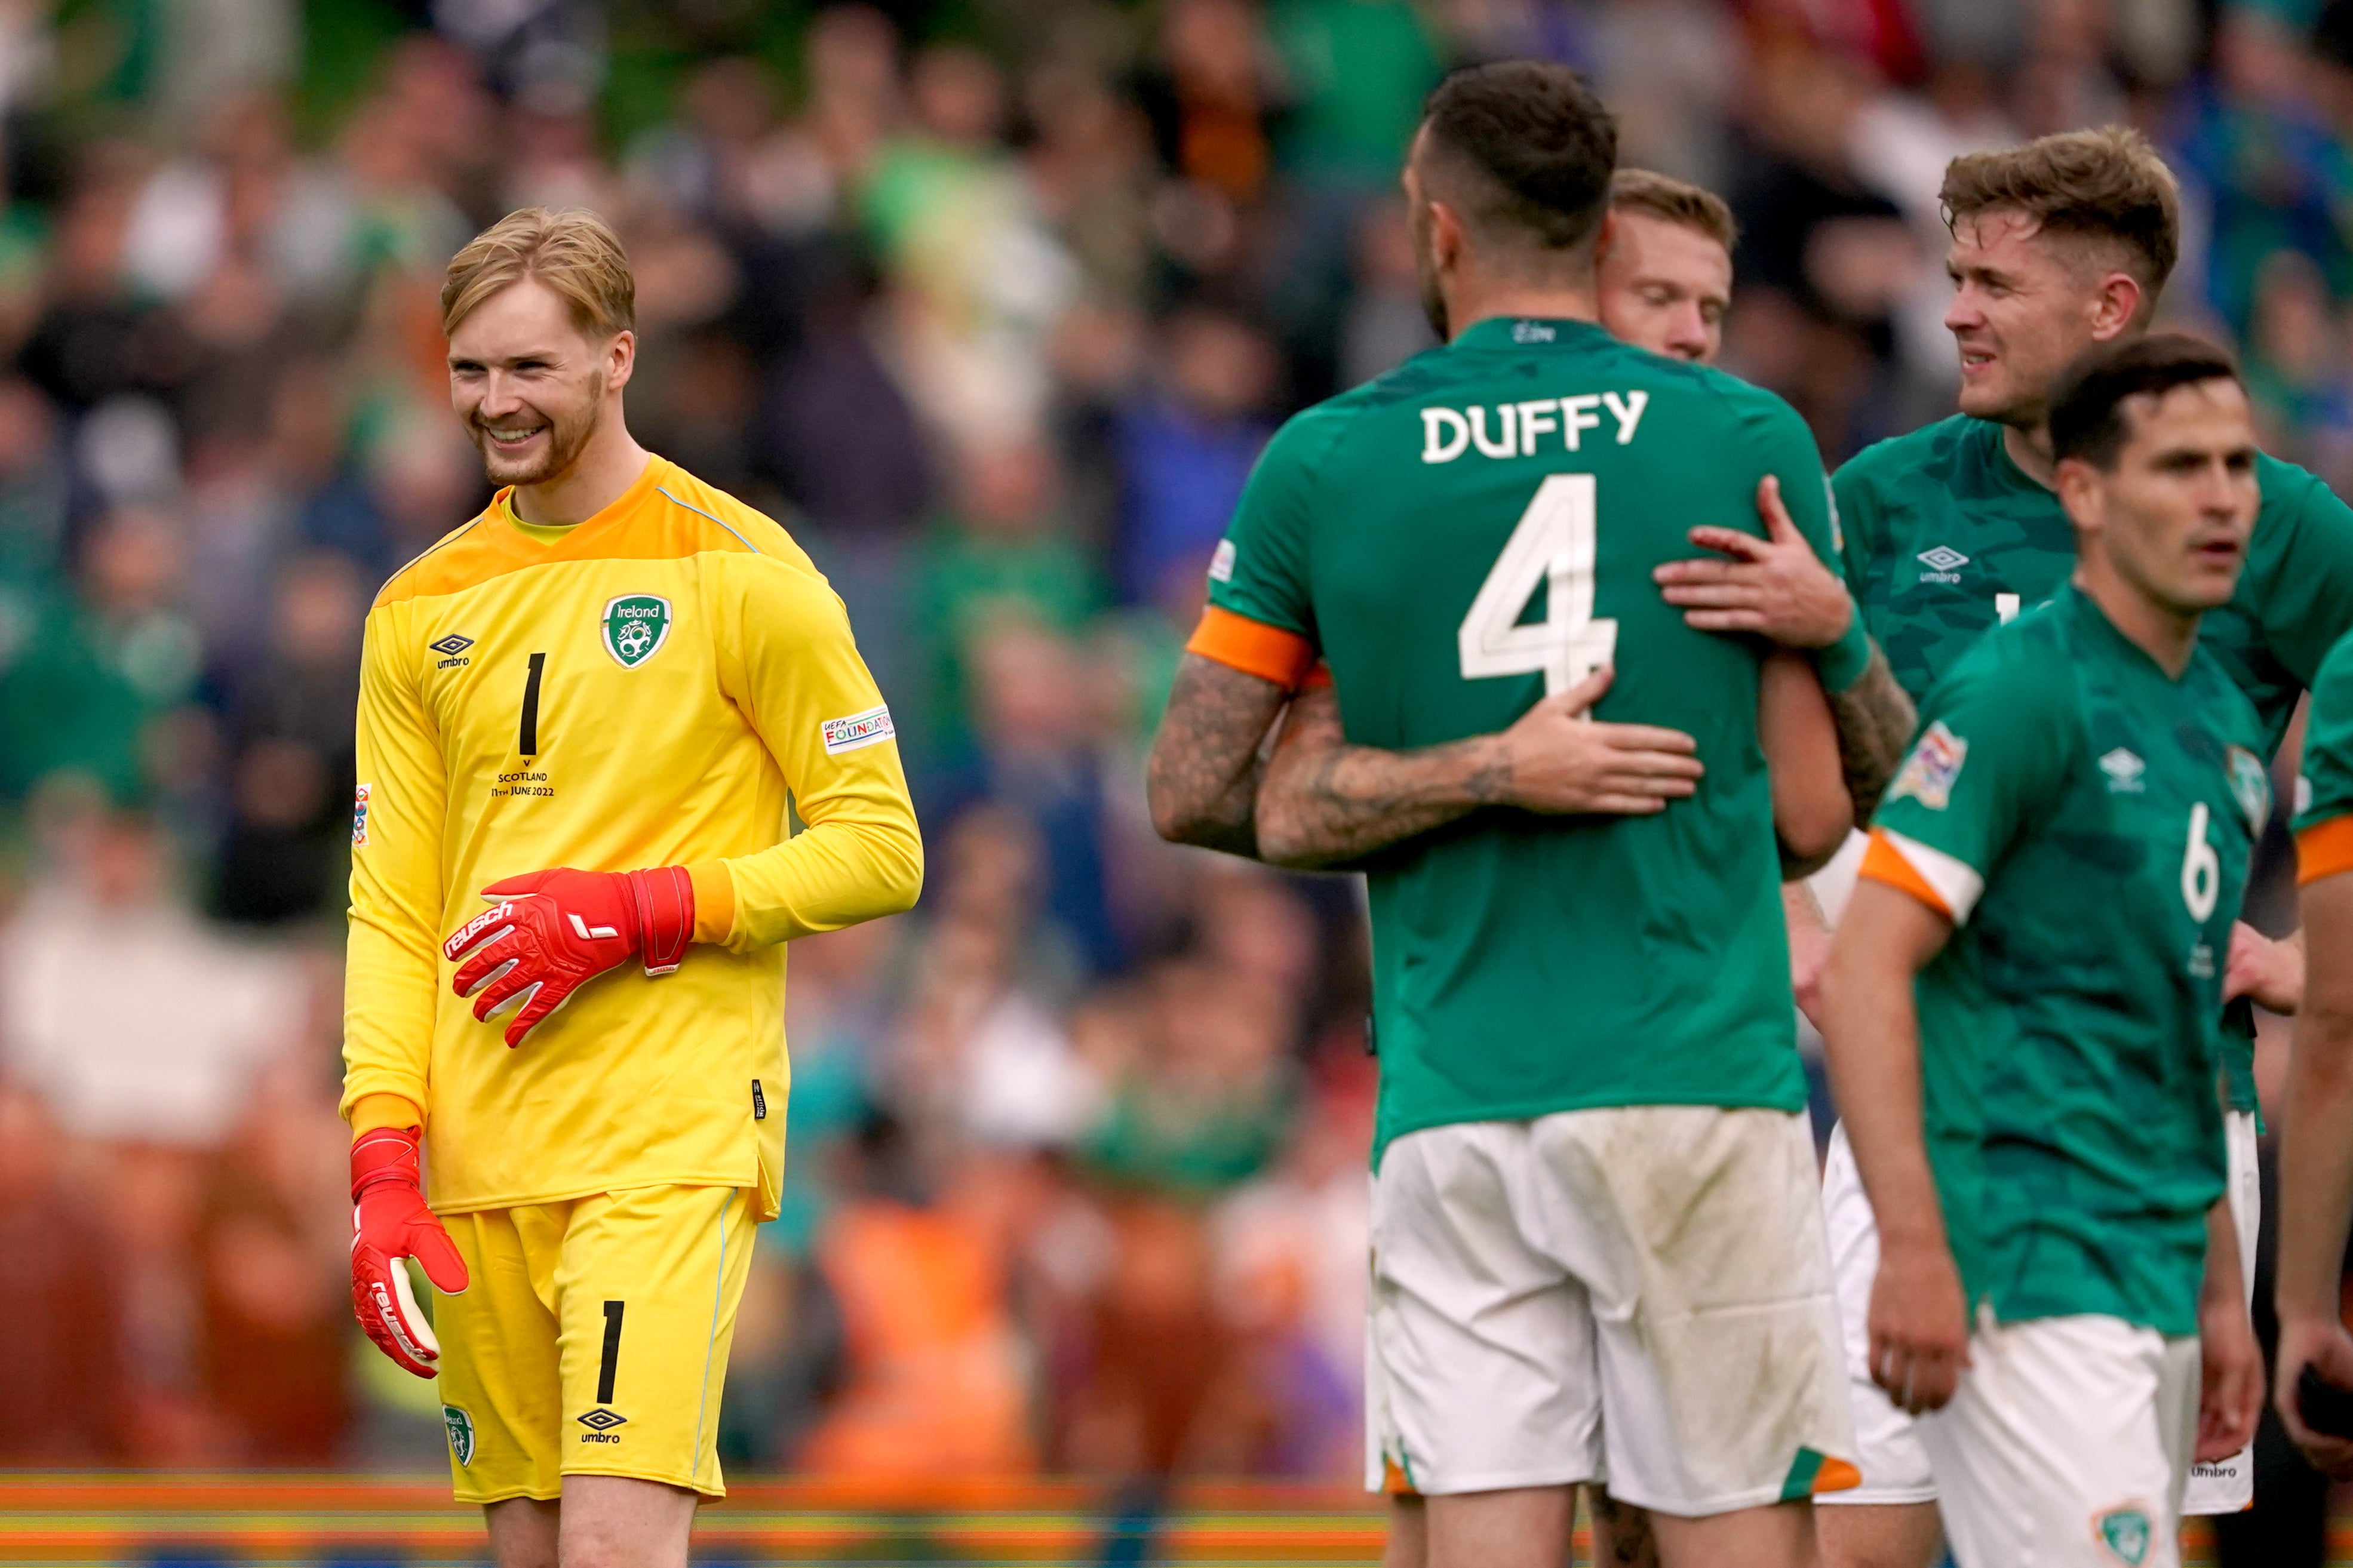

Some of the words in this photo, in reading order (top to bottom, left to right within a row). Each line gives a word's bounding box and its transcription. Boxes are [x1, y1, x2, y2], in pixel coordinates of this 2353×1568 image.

[1420, 391, 1649, 465] DUFFY
[1458, 473, 1618, 708] 4
[617, 604, 659, 618] Ireland
[438, 657, 469, 670] umbro
[519, 653, 546, 755] 1
[824, 720, 847, 730] UEFA
[826, 715, 891, 743] FOUNDATION
[498, 772, 548, 783] SCOTLAND
[511, 785, 531, 795] JUNE
[532, 786, 554, 797] 2022
[2181, 803, 2218, 923] 6
[446, 900, 514, 958] reusch
[597, 1300, 625, 1404] 1
[581, 1431, 621, 1444] umbro
